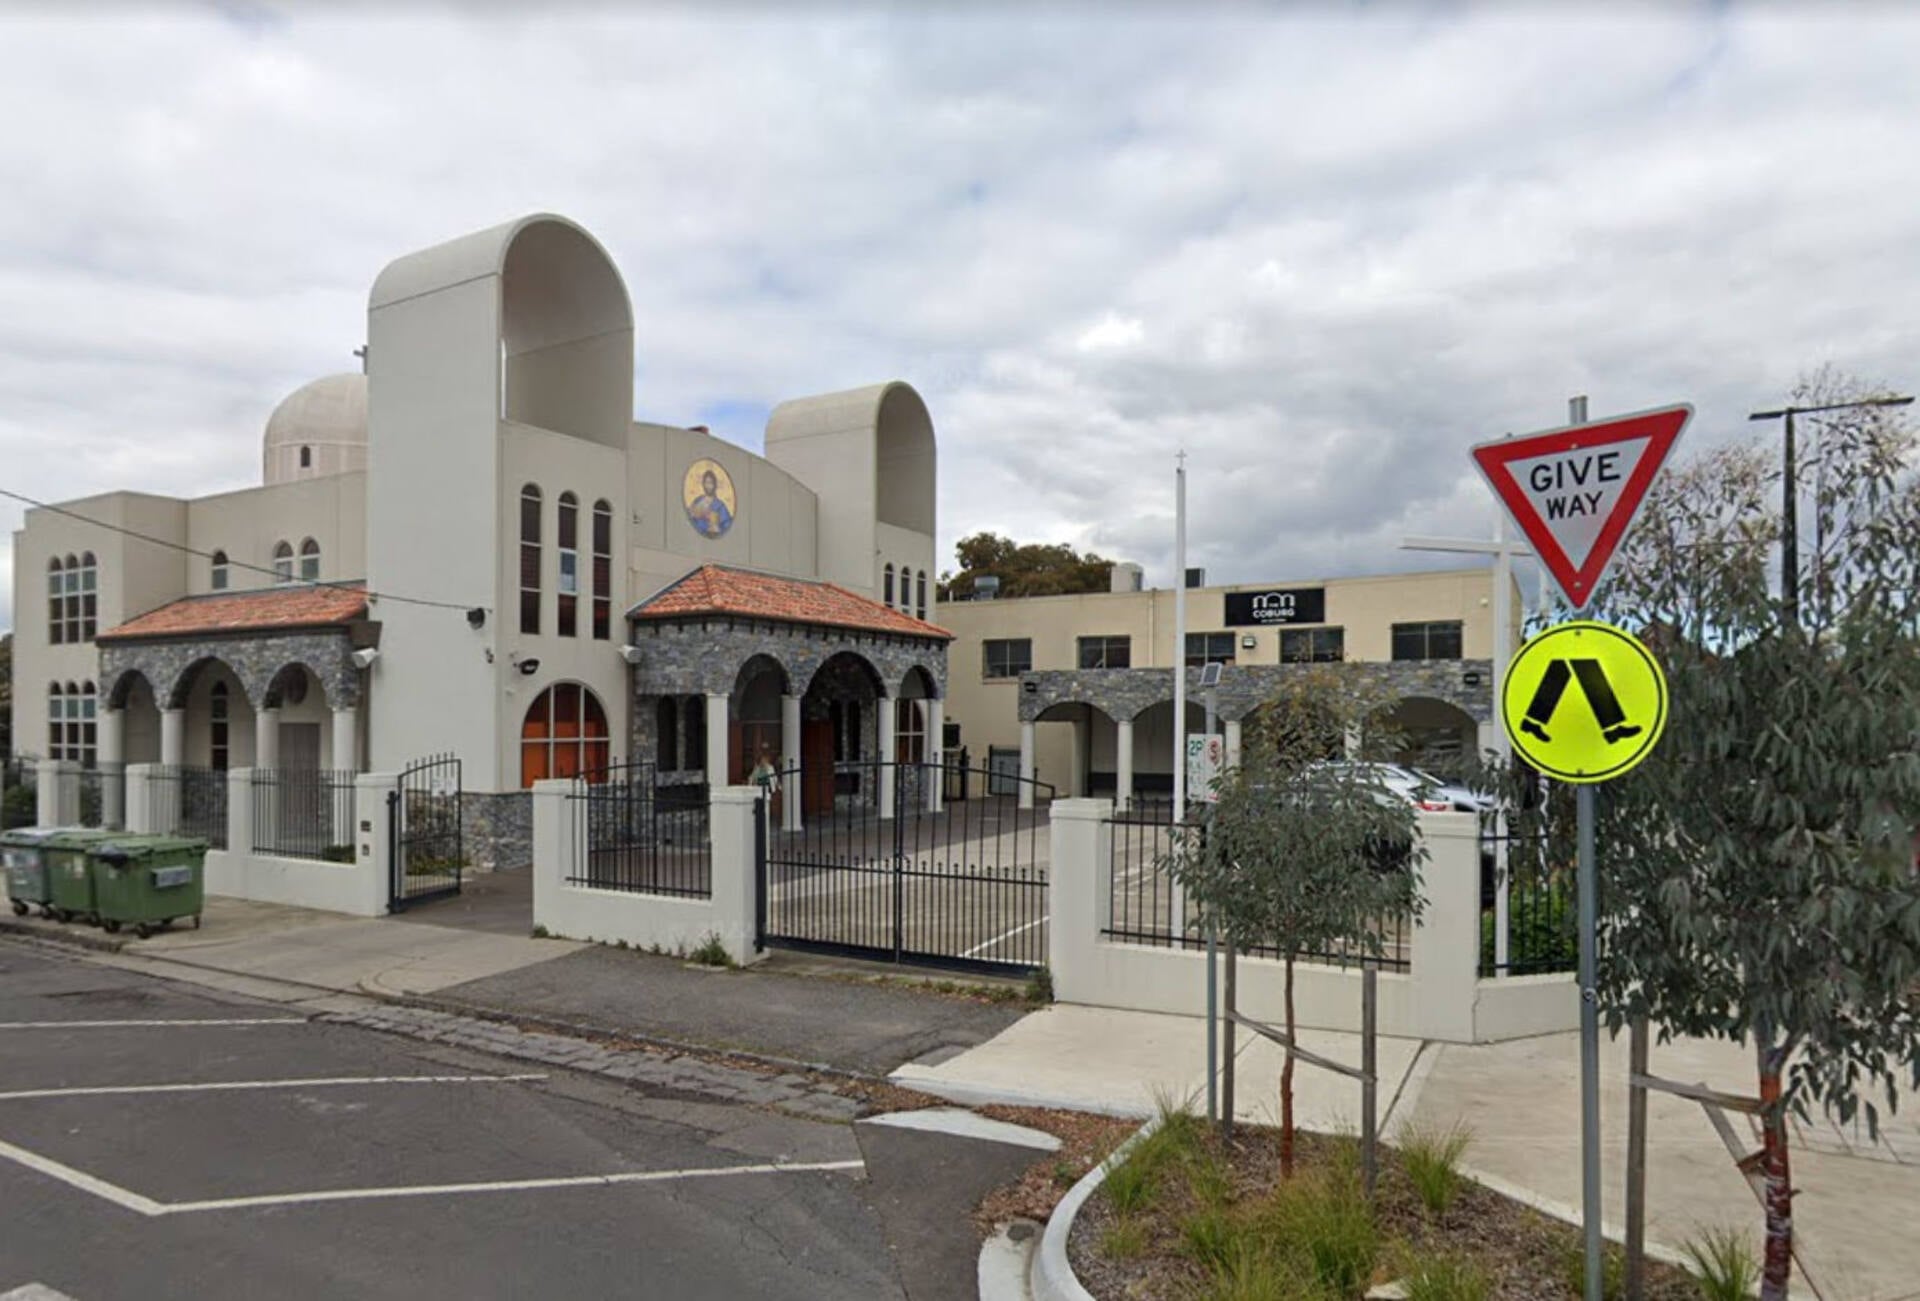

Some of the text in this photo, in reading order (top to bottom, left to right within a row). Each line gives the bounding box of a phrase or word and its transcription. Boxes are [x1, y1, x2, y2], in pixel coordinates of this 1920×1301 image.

[1530, 452, 1620, 492] GIVE
[1546, 491, 1603, 520] WAY
[1253, 608, 1295, 619] COBURG
